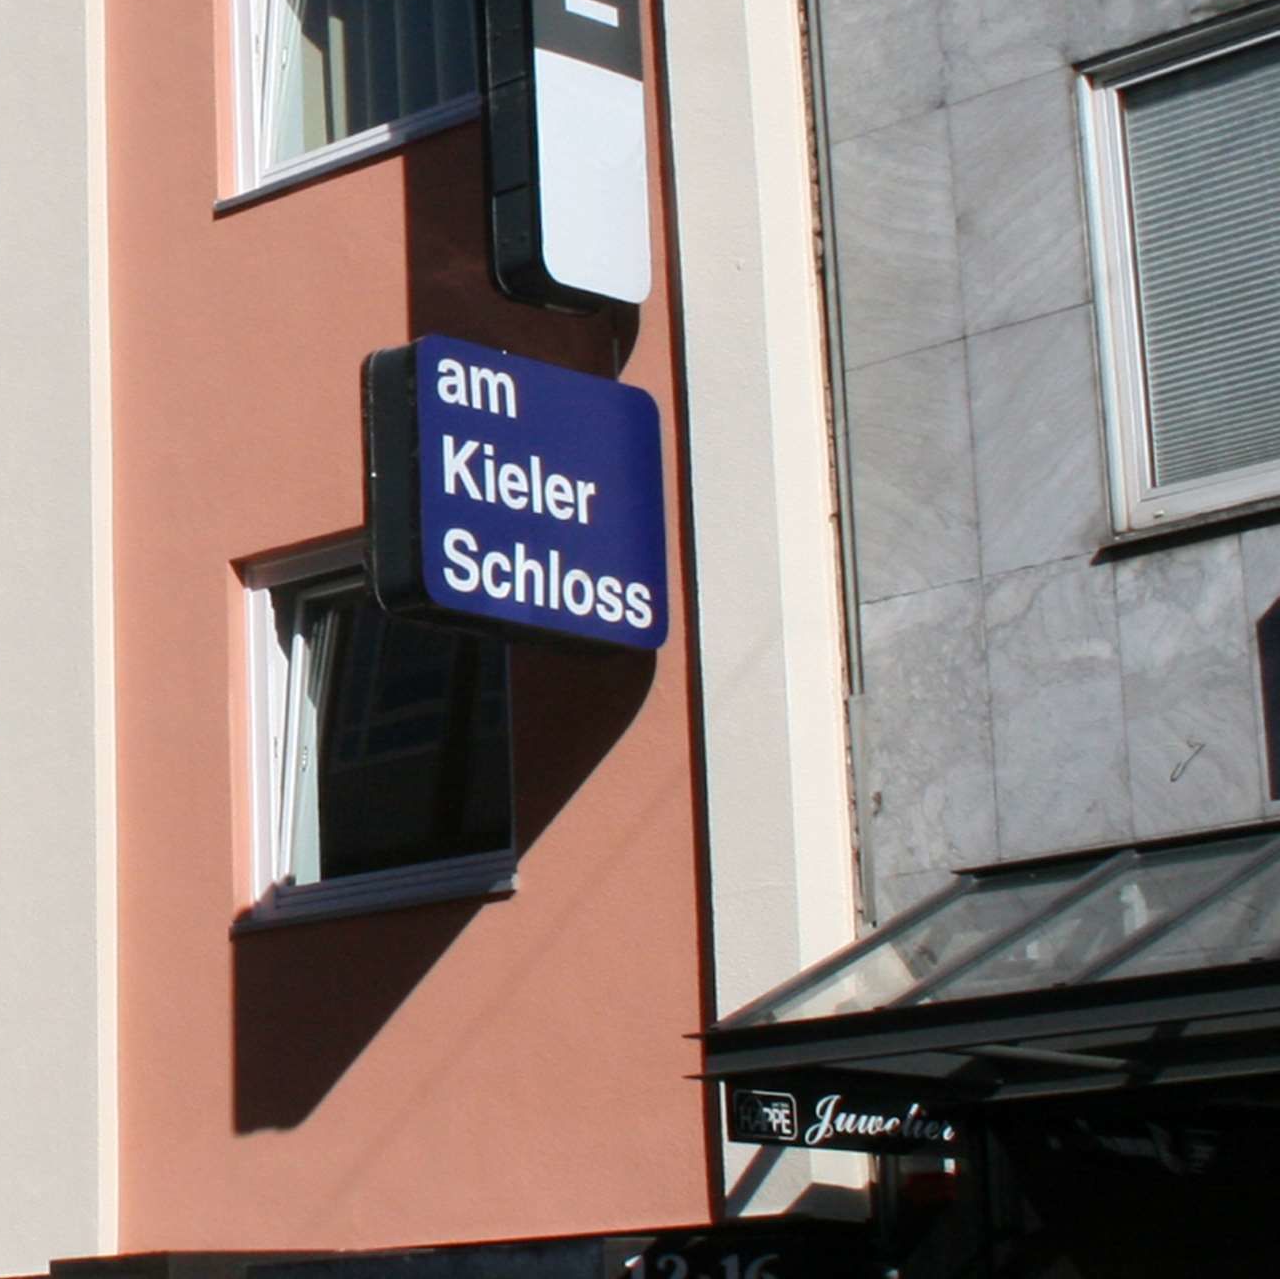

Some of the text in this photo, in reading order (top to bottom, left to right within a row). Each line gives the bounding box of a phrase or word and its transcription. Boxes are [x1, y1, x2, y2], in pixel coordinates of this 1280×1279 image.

[437, 357, 517, 419] am
[442, 434, 596, 525] Kieler
[442, 527, 654, 630] Schloss
[804, 1093, 959, 1147] Juwelier
